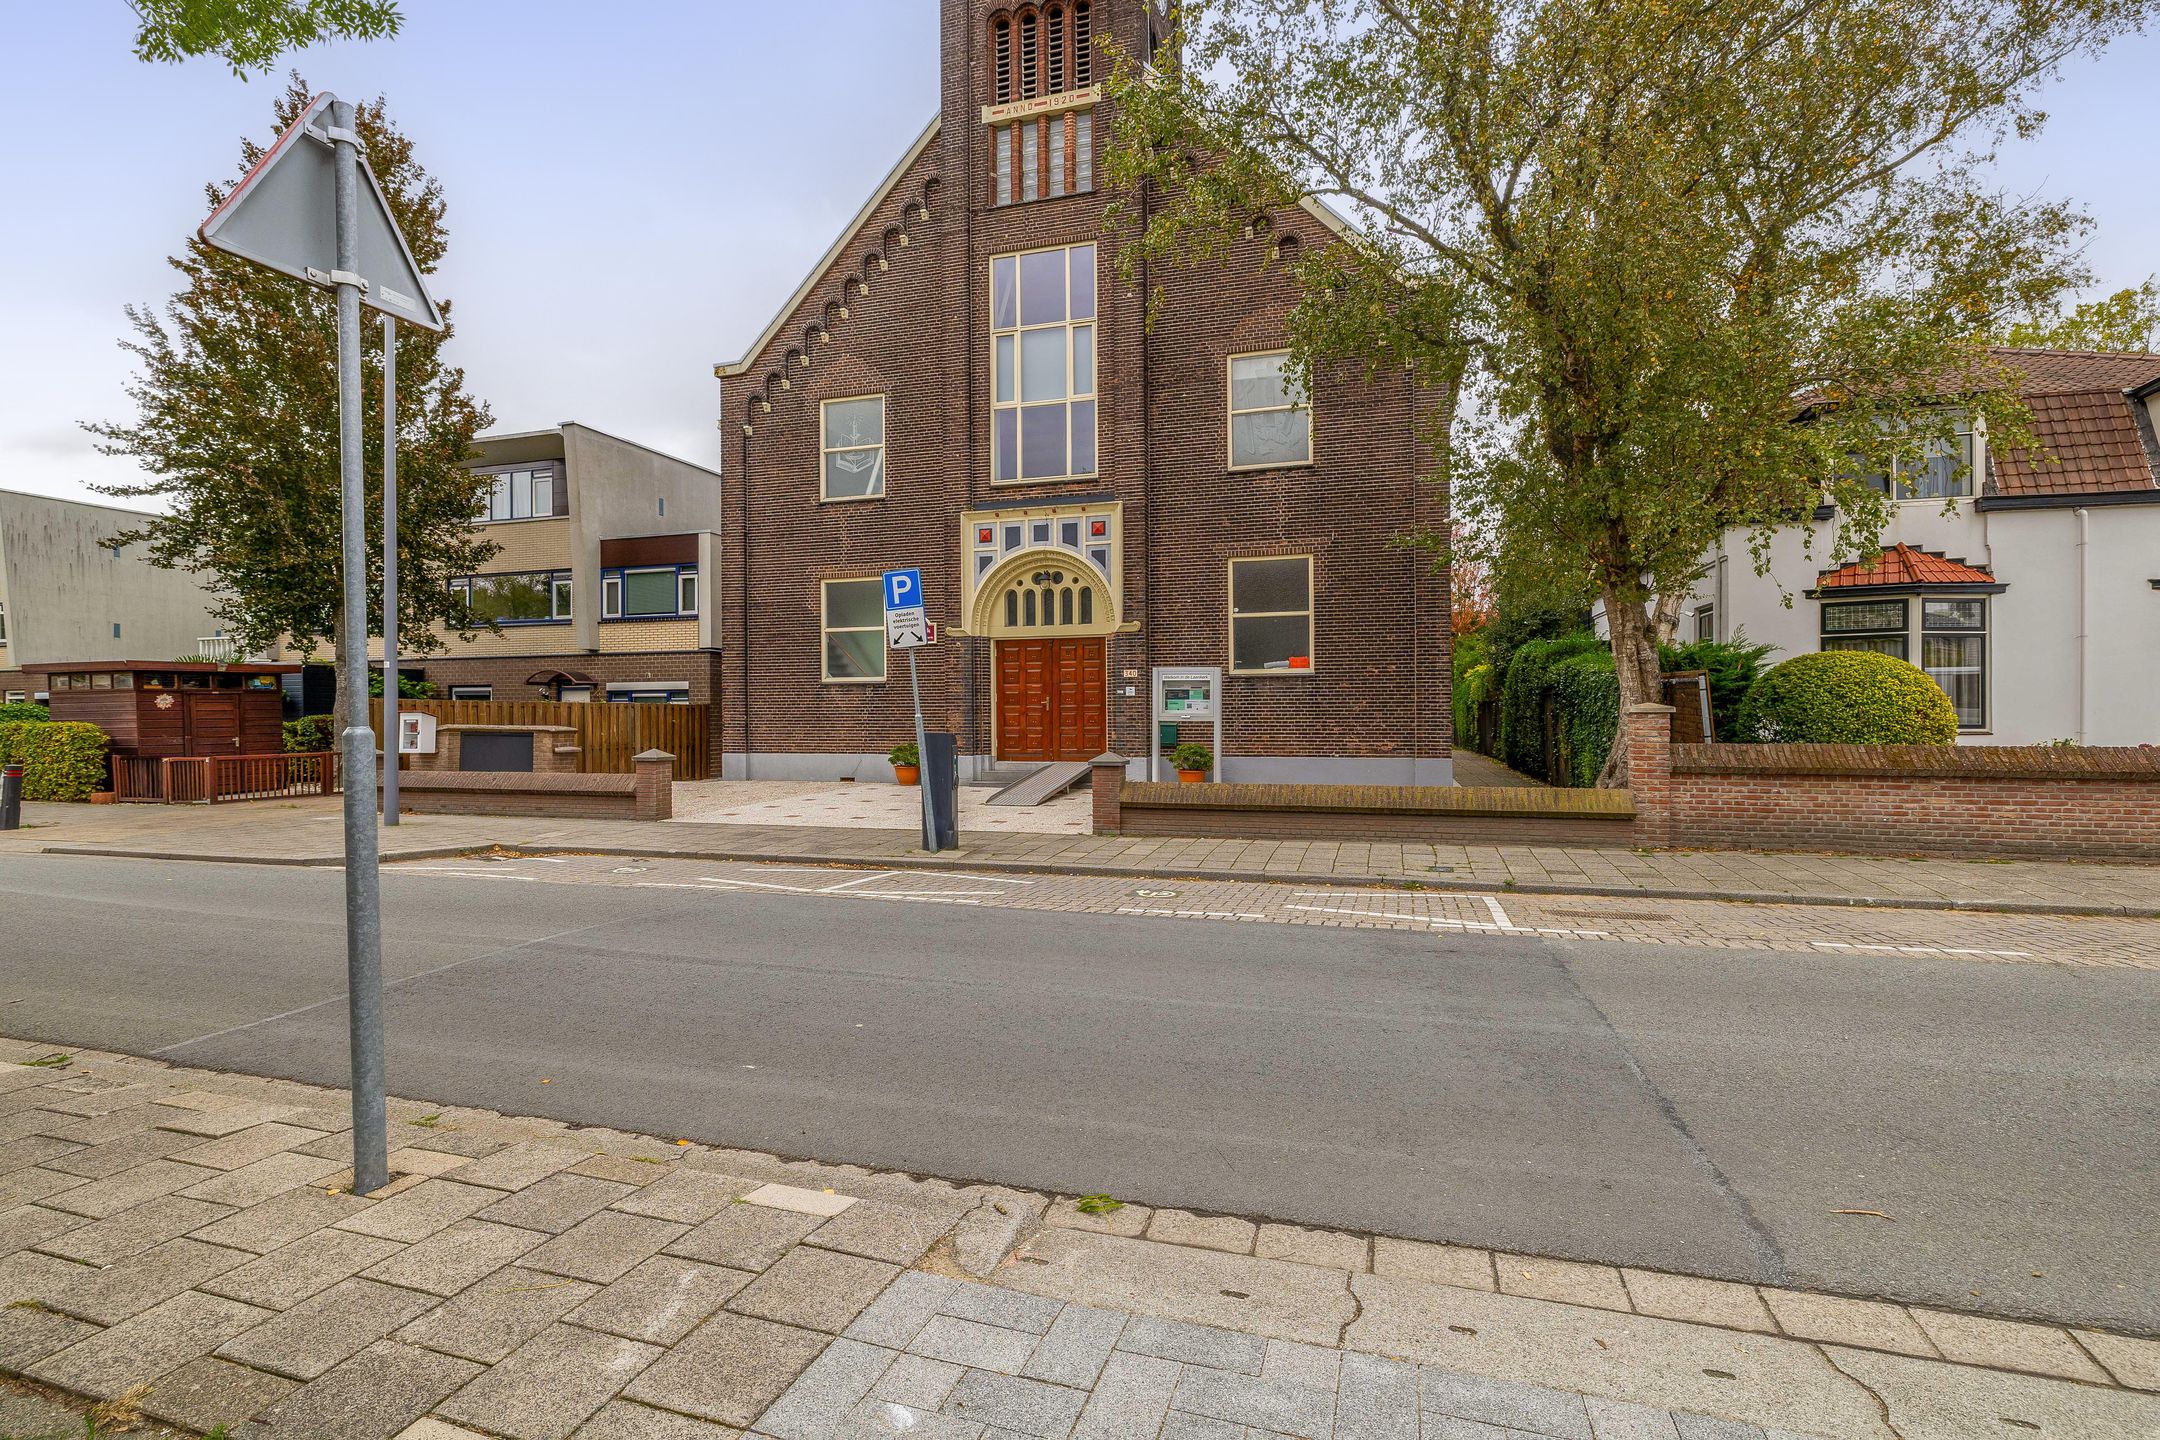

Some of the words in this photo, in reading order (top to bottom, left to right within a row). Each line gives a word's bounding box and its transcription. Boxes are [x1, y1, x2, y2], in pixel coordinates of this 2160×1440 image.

[1006, 102, 1033, 115] ANNO
[1049, 94, 1075, 107] 1920
[892, 575, 912, 604] P
